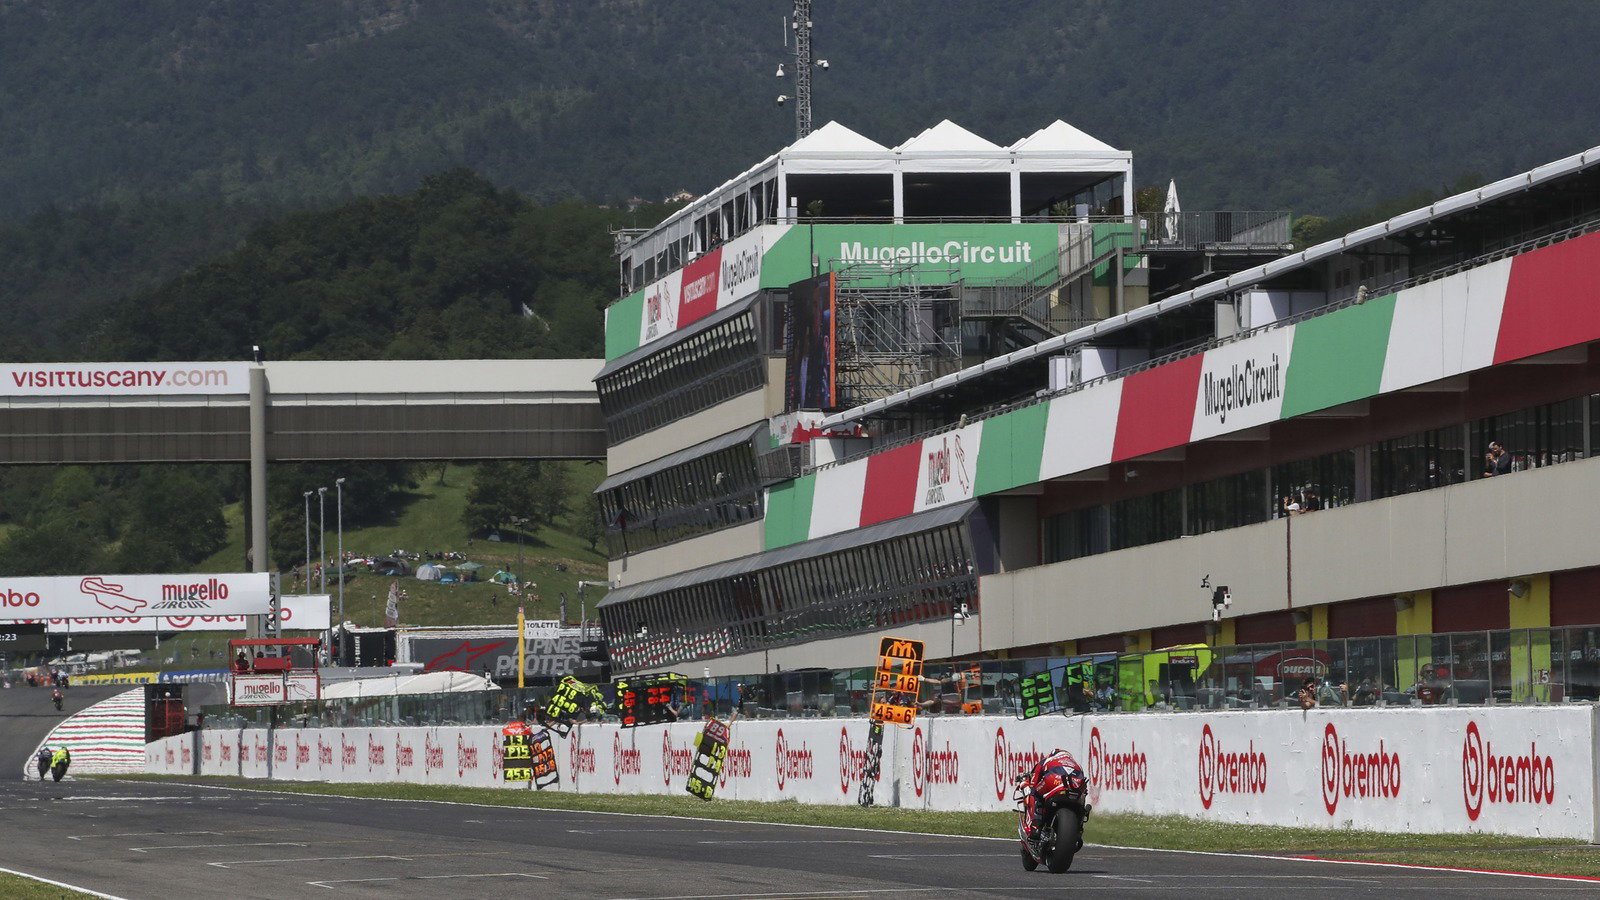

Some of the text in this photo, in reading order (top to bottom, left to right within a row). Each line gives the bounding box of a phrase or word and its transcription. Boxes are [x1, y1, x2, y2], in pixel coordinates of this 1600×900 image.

[840, 241, 1031, 268] MugelloCircuit
[1204, 353, 1279, 424] MugelloCircuit
[162, 579, 228, 601] mugello
[151, 600, 212, 609] CIRCUIT
[882, 658, 913, 675] L 1
[1283, 665, 1321, 674] DUCATI
[244, 681, 280, 695] mugello
[557, 683, 577, 700] P19
[880, 674, 889, 688] P
[898, 676, 915, 690] 16
[507, 744, 529, 758] P15
[785, 740, 813, 779] brembo
[925, 740, 959, 784] brembo
[1104, 741, 1147, 791] brembo
[1217, 739, 1267, 793] brembo
[1343, 739, 1401, 798] brembo
[1486, 741, 1555, 805] brembo
